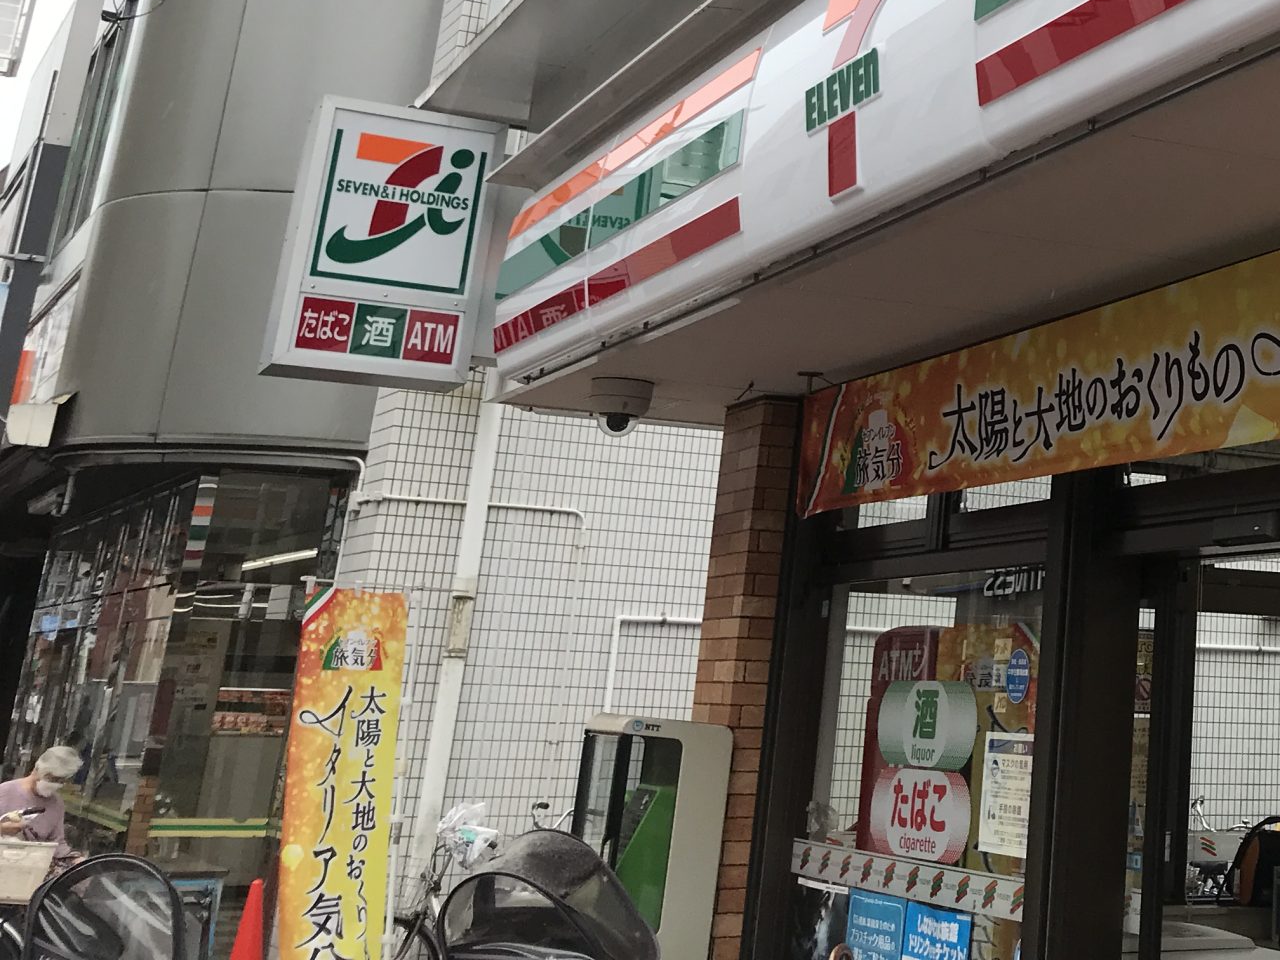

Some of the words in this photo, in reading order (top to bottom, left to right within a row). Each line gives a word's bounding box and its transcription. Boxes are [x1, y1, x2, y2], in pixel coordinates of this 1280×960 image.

[805, 47, 881, 134] ELEVEN
[400, 189, 470, 211] HOLDINGS
[300, 308, 351, 342] たばこ
[362, 315, 397, 347] 酒
[407, 321, 454, 355] ATM
[929, 331, 1247, 470] 太陽と大地のおくりもの
[855, 441, 903, 486] 旅気分
[644, 723, 662, 733] NTT
[913, 688, 940, 740] 酒
[911, 744, 936, 763] liquor
[343, 686, 387, 960] 太陽と大地のおくり
[891, 778, 947, 833] たばこ
[899, 834, 937, 855] cigarette
